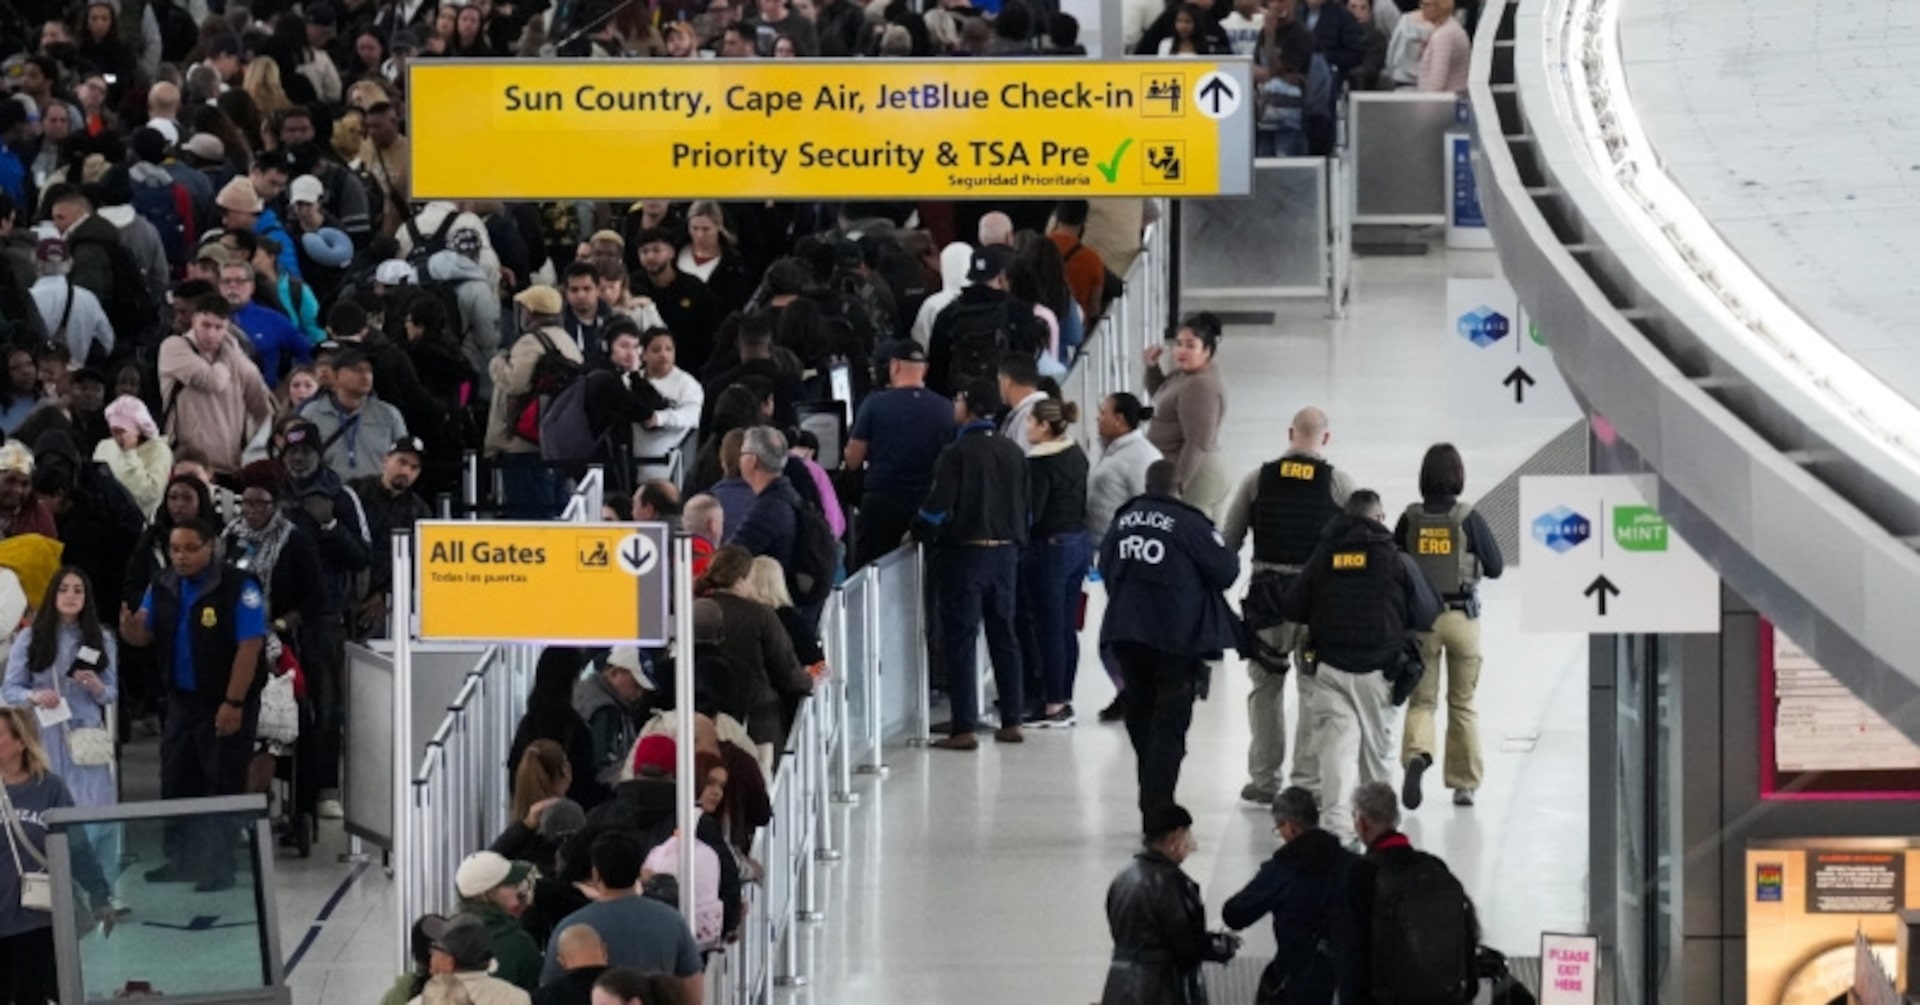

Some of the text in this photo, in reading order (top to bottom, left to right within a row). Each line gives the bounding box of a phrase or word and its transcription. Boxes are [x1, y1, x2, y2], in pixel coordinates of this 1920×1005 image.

[504, 82, 1133, 118] Sun Country, Cape Air, JetBlue Check-in
[671, 141, 1090, 174] Priority Security & TSA Pre
[948, 174, 1090, 187] Seguridad Prioritaria
[1280, 461, 1315, 480] ERO
[1118, 510, 1175, 532] POLICE
[1616, 526, 1664, 541] MINT
[430, 541, 546, 564] All Gates
[1418, 537, 1452, 555] ERO
[1333, 553, 1366, 569] ERO
[484, 573, 527, 586] puertas
[1549, 948, 1590, 963] PLEASE
[1557, 964, 1581, 977] EXIT
[1554, 979, 1582, 992] HERE
